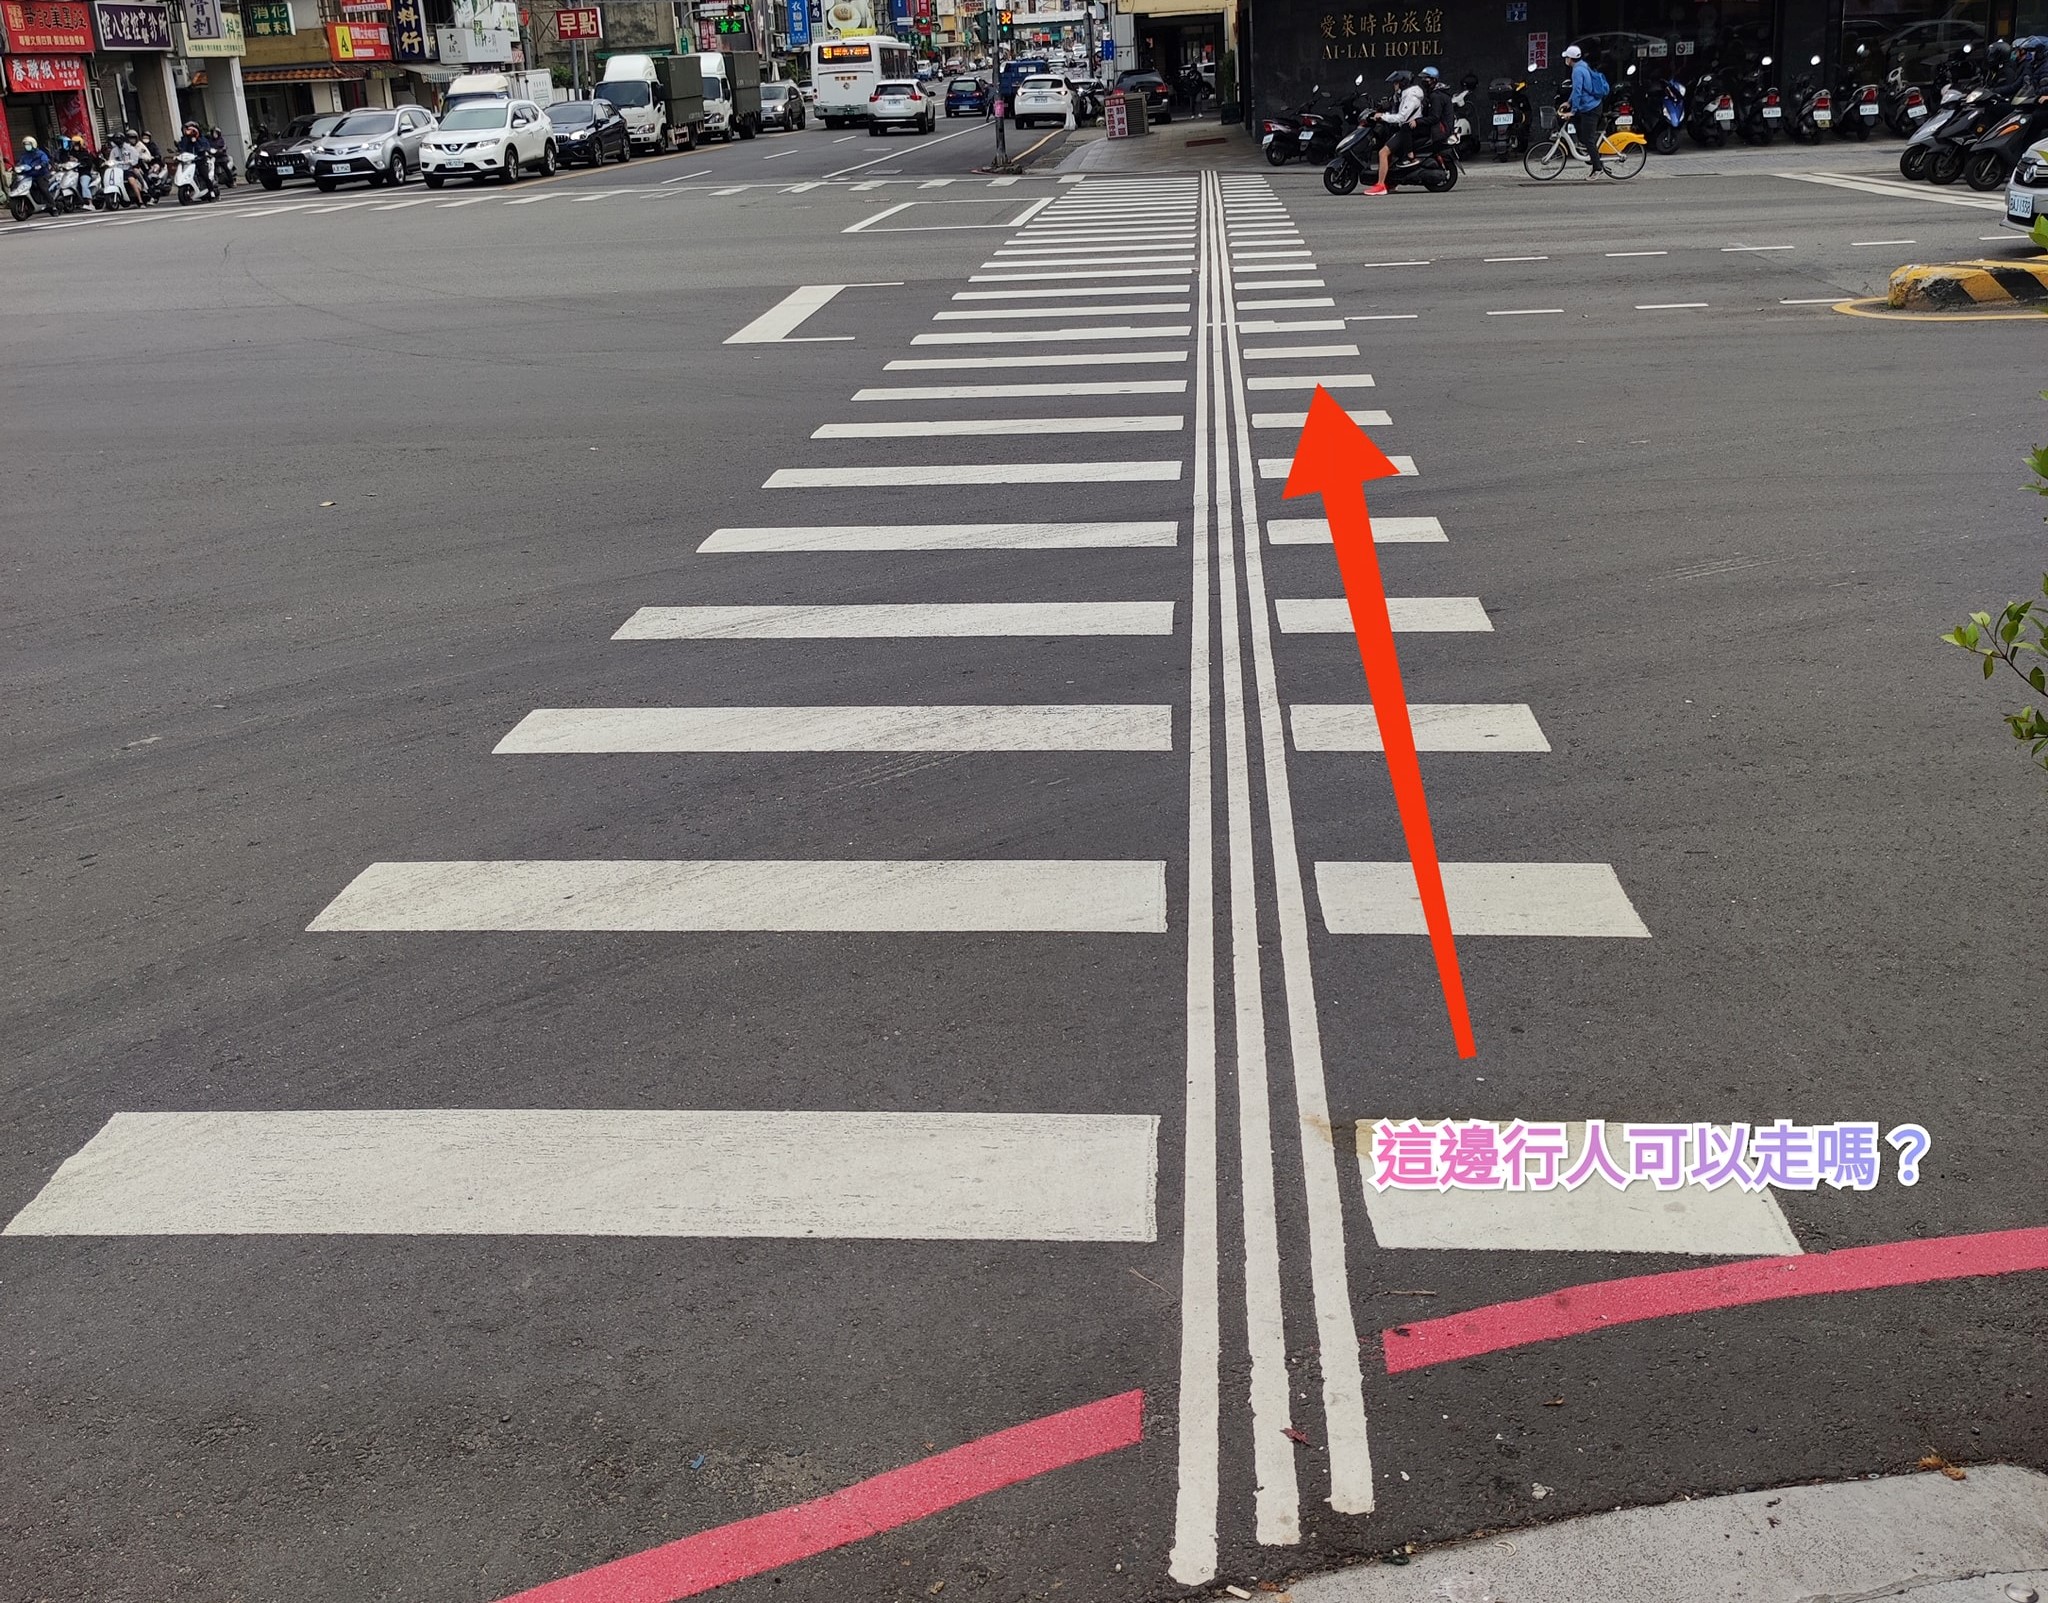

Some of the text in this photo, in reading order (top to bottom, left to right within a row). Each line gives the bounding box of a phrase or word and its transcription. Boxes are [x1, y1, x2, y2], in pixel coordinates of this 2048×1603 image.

[253, 6, 283, 19] 消化
[1001, 12, 1012, 25] 32
[559, 11, 598, 37] 早點
[1322, 40, 1443, 60] AI-LAI HOTEL
